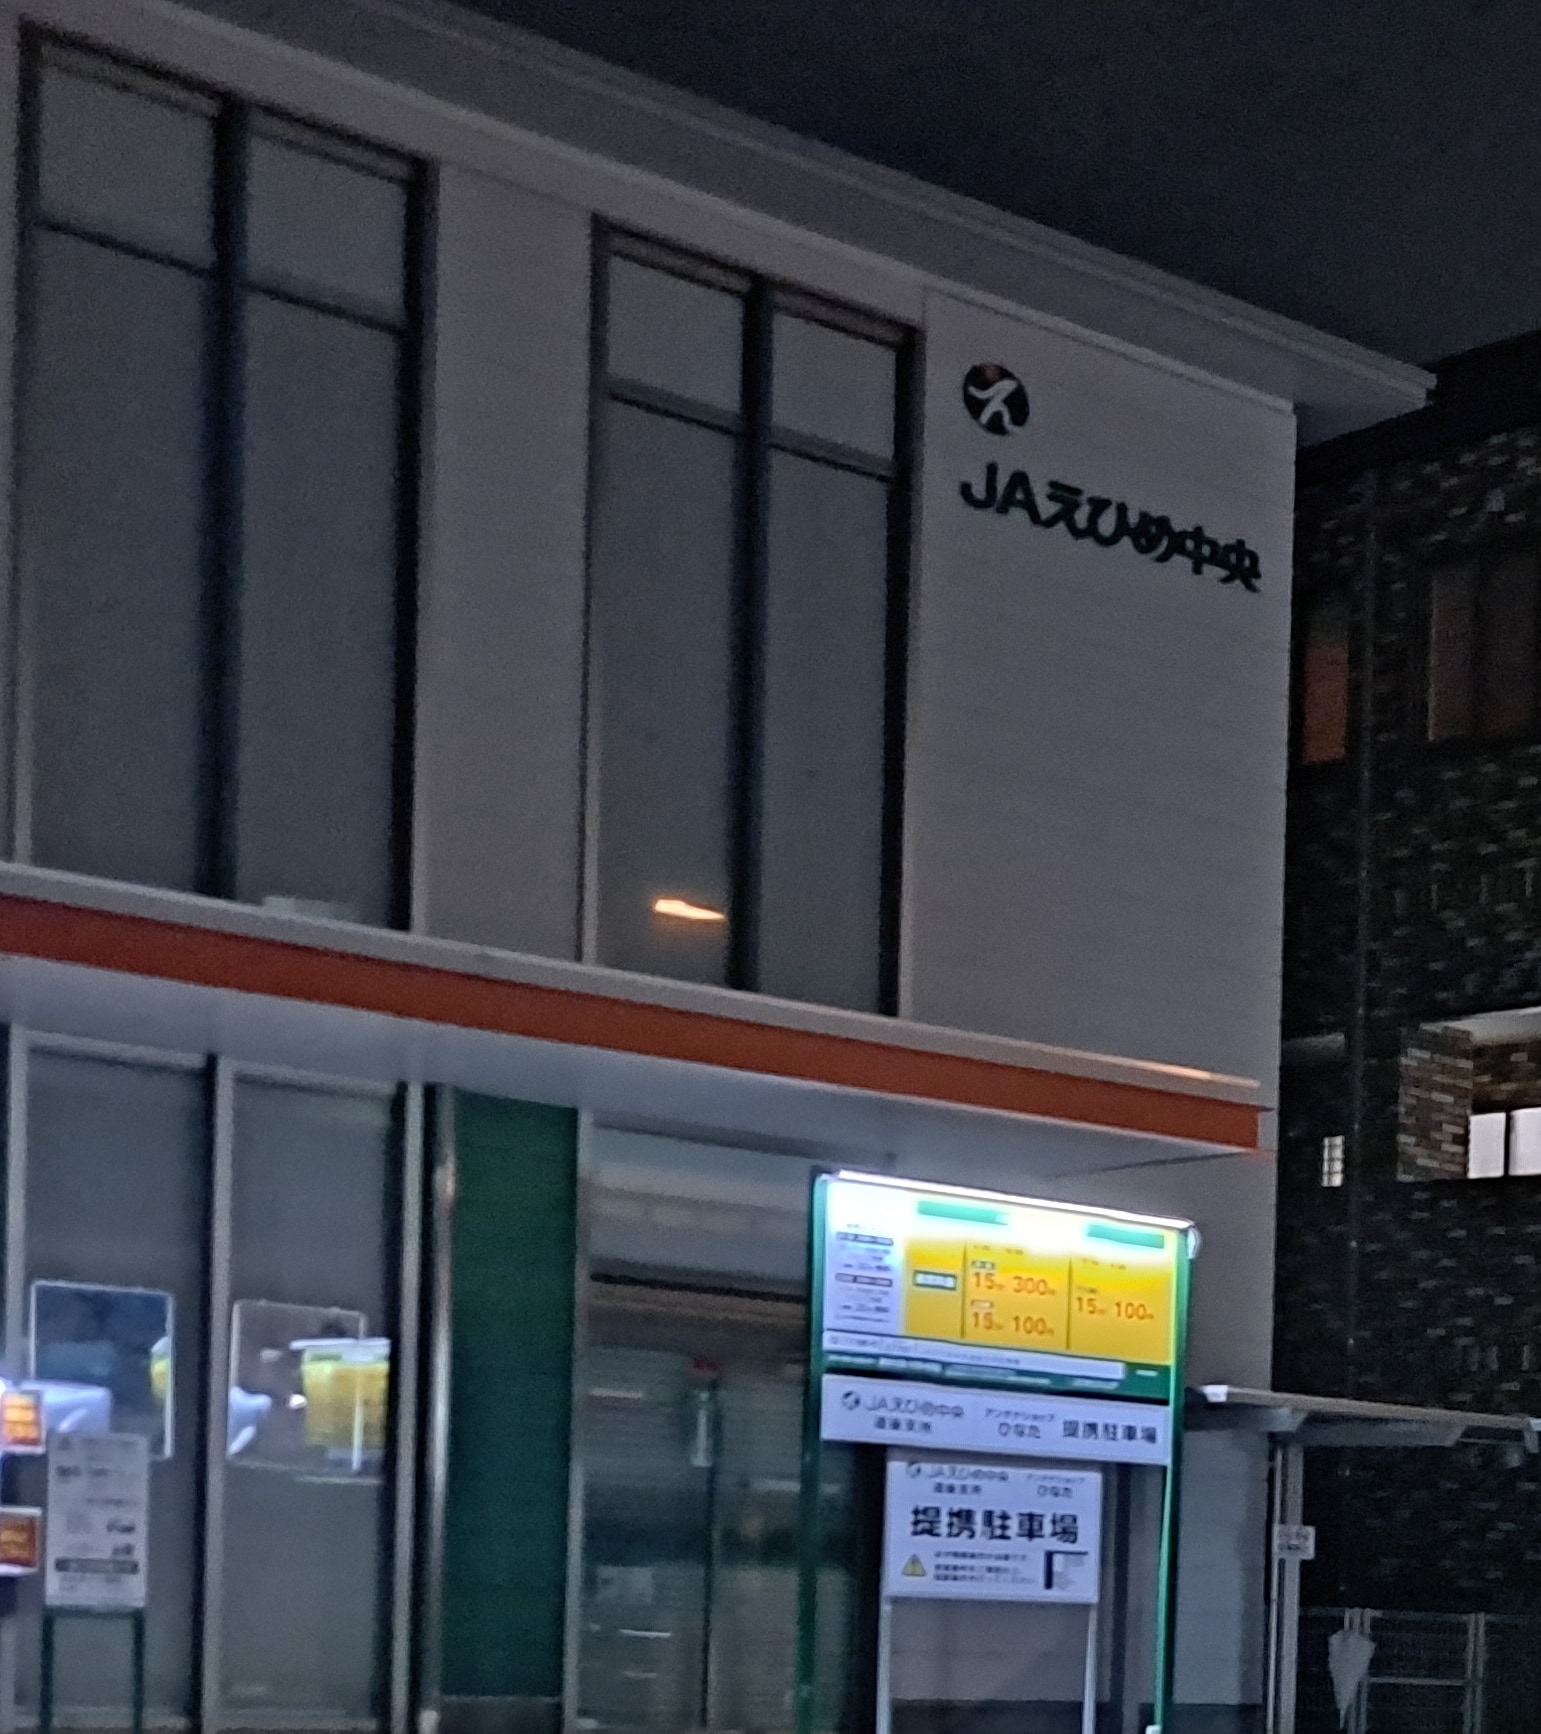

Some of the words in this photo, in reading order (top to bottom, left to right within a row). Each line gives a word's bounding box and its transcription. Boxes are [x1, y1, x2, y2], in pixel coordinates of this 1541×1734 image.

[911, 1506, 1079, 1544] 提携駐車場
